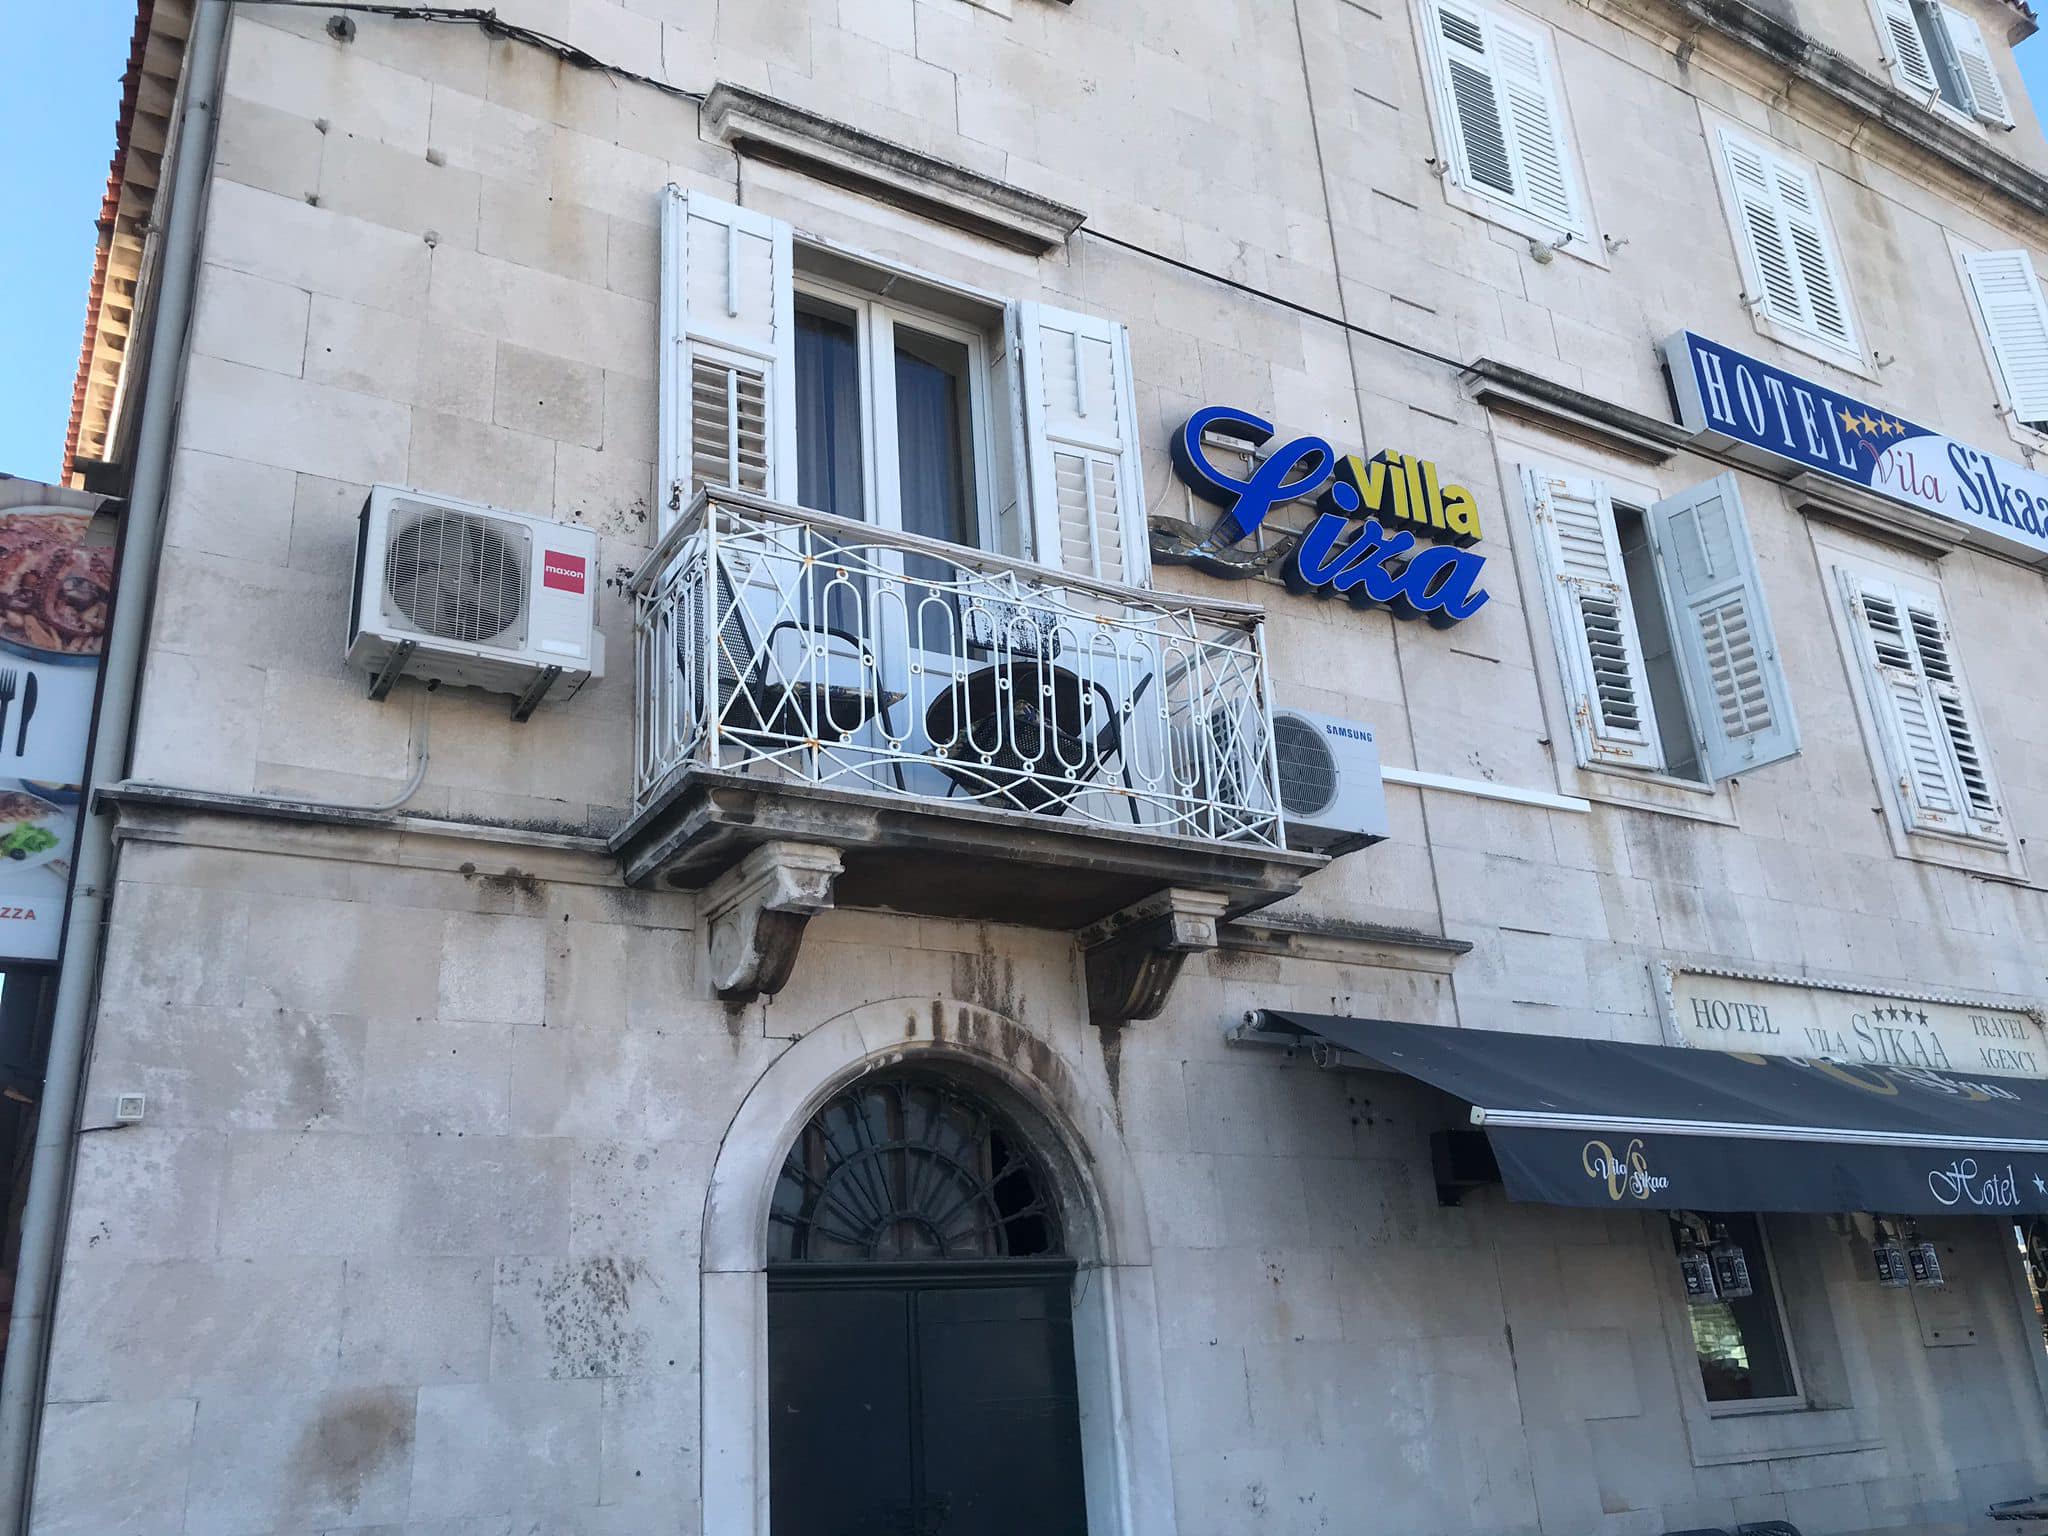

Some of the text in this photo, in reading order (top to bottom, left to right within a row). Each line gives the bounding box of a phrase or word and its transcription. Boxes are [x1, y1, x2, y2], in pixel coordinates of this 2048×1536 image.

[1696, 348, 1858, 472] HOTEL
[1859, 439, 1947, 504] Vila
[1345, 449, 1484, 542] villa
[545, 564, 584, 580] maxon
[1326, 724, 1373, 743] SAMSUNG
[1690, 998, 1953, 1069] HOTEL VILA SIKAA
[1968, 1014, 2030, 1040] TRAVEL
[1979, 1047, 2039, 1073] AGENCY
[1928, 1157, 2022, 1208] Hotel
